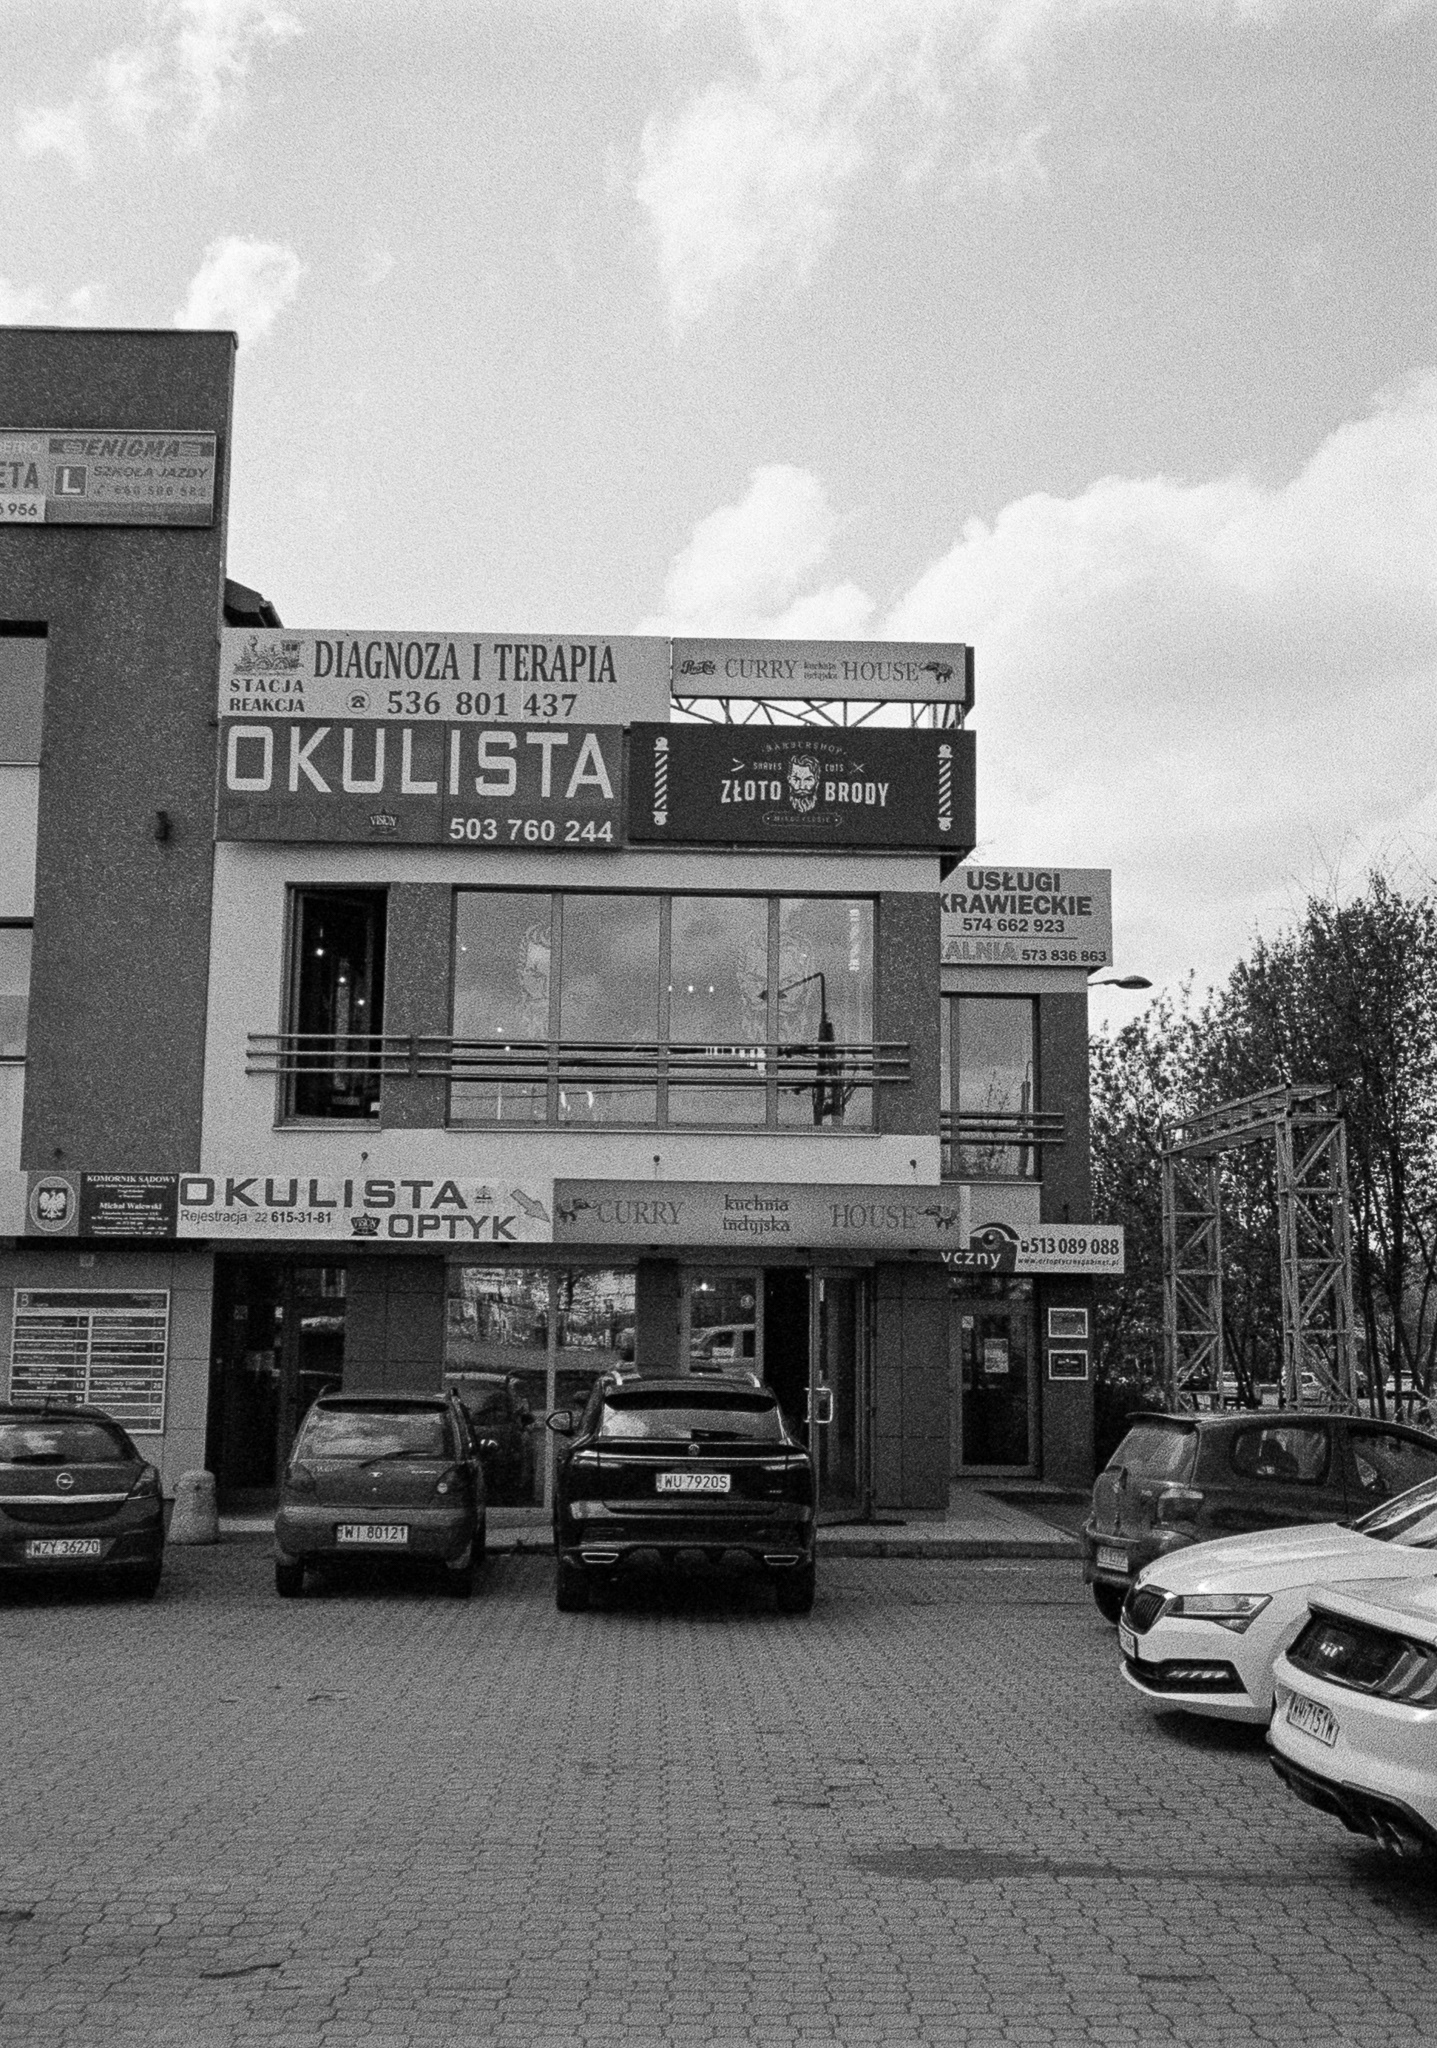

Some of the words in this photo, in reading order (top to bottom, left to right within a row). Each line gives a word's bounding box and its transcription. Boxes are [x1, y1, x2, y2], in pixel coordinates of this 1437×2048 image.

[85, 439, 180, 457] ENIGMA
[8, 503, 38, 516] 956
[314, 639, 460, 681] DIAGNOZA
[473, 643, 482, 681] I
[494, 643, 618, 684] TERAPIA
[725, 659, 799, 679] CURRY
[842, 661, 919, 682] HOUSE
[230, 678, 304, 693] STACJA
[229, 696, 305, 713] REAKCJA
[387, 691, 441, 715] 536
[456, 692, 509, 716] 801
[523, 693, 578, 717] 437
[226, 724, 614, 800] OKULISTA
[825, 763, 845, 773] CUTS
[721, 779, 782, 803] ZŁOTO
[825, 781, 889, 807] BRODY
[449, 818, 498, 841] 503
[508, 819, 555, 841] 760
[565, 820, 613, 842] 244
[966, 870, 1060, 892] USŁUGI
[963, 918, 992, 932] 574
[997, 918, 1028, 932] 662
[1033, 919, 1065, 933] 923
[1021, 949, 1047, 961] 573
[1050, 949, 1077, 962] 836
[1081, 950, 1107, 962] 863
[87, 1175, 137, 1183] KOMORNIK
[138, 1175, 177, 1185] SĄDOWY
[180, 1177, 468, 1209] OKULISTA
[725, 1194, 789, 1212] kuchnia
[180, 1210, 247, 1225] Rejestracja
[254, 1212, 268, 1223] 22
[271, 1211, 331, 1224] 615-31-81
[595, 1200, 684, 1225] CURRY
[829, 1203, 917, 1230] HOUSE
[388, 1214, 517, 1240] OPTYK
[723, 1215, 790, 1236] indyjska
[1030, 1237, 1056, 1254] 513
[1058, 1238, 1087, 1255] 089
[1090, 1238, 1119, 1255] 088
[664, 1475, 683, 1488] WU
[686, 1475, 728, 1489] 7920S
[344, 1526, 361, 1539] WI
[367, 1526, 405, 1540] 80121
[33, 1540, 58, 1555] WZY
[62, 1540, 99, 1554] 36270
